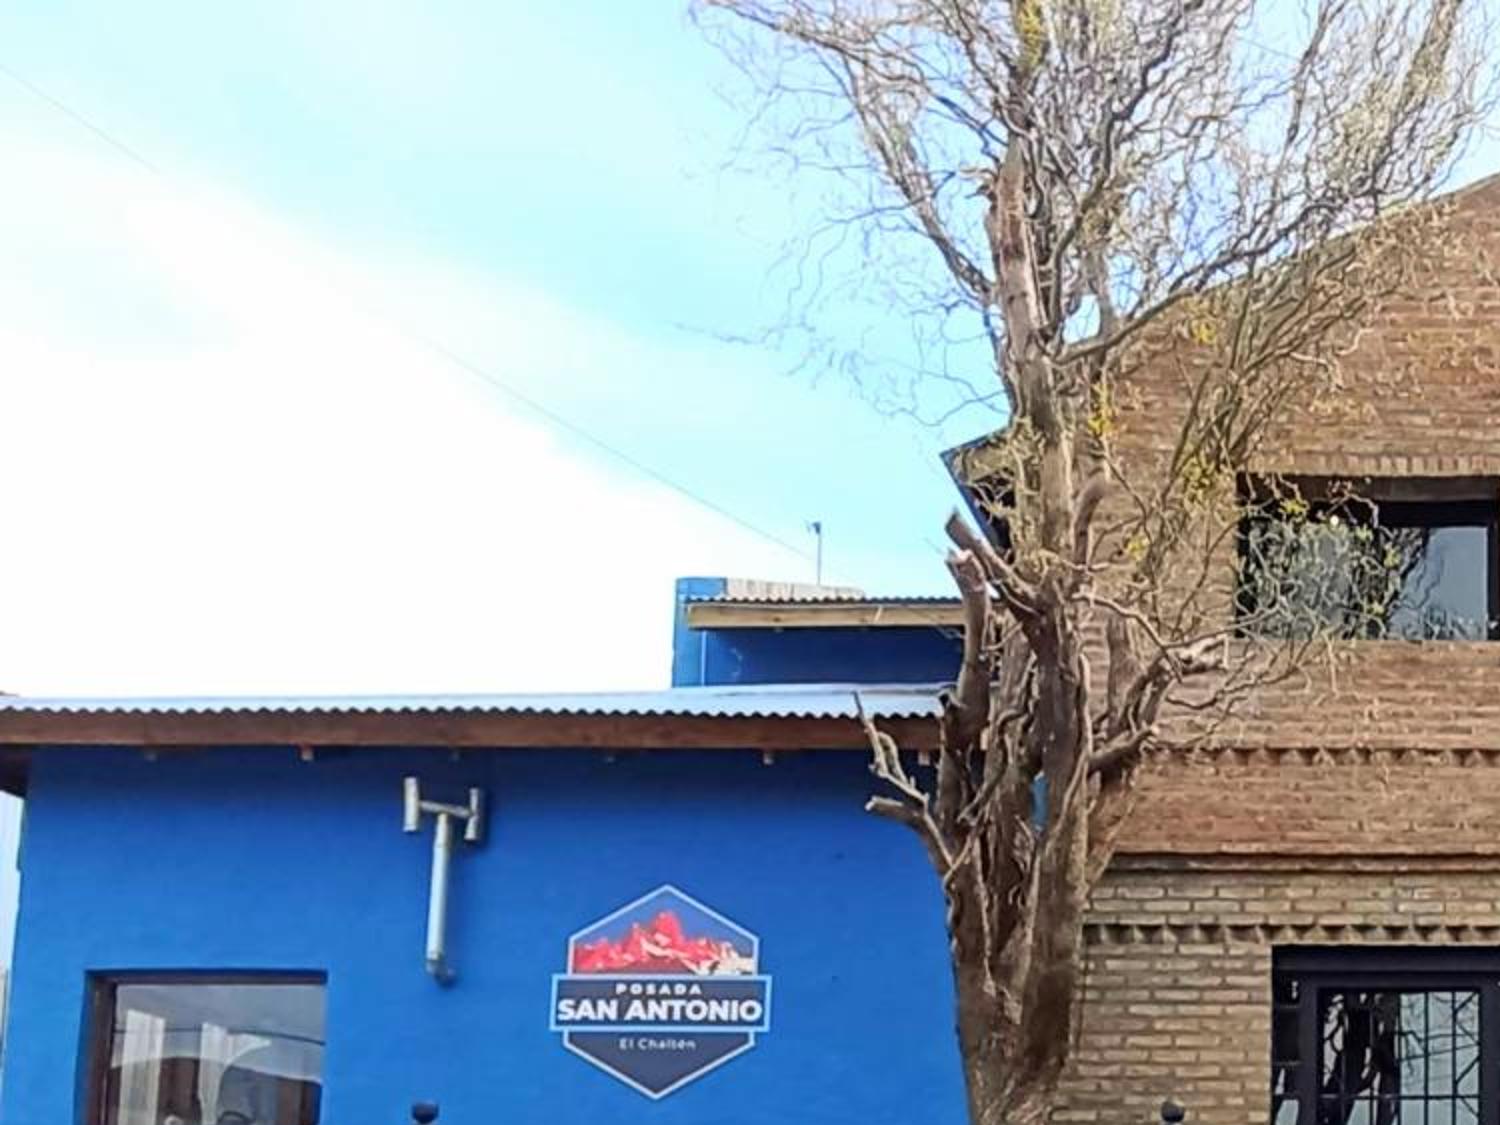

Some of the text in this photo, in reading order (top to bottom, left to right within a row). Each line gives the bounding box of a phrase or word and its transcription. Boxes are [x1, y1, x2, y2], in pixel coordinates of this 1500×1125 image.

[615, 983, 703, 995] POSADA
[557, 999, 763, 1021] SAN ANTONIO
[619, 1037, 635, 1050] El
